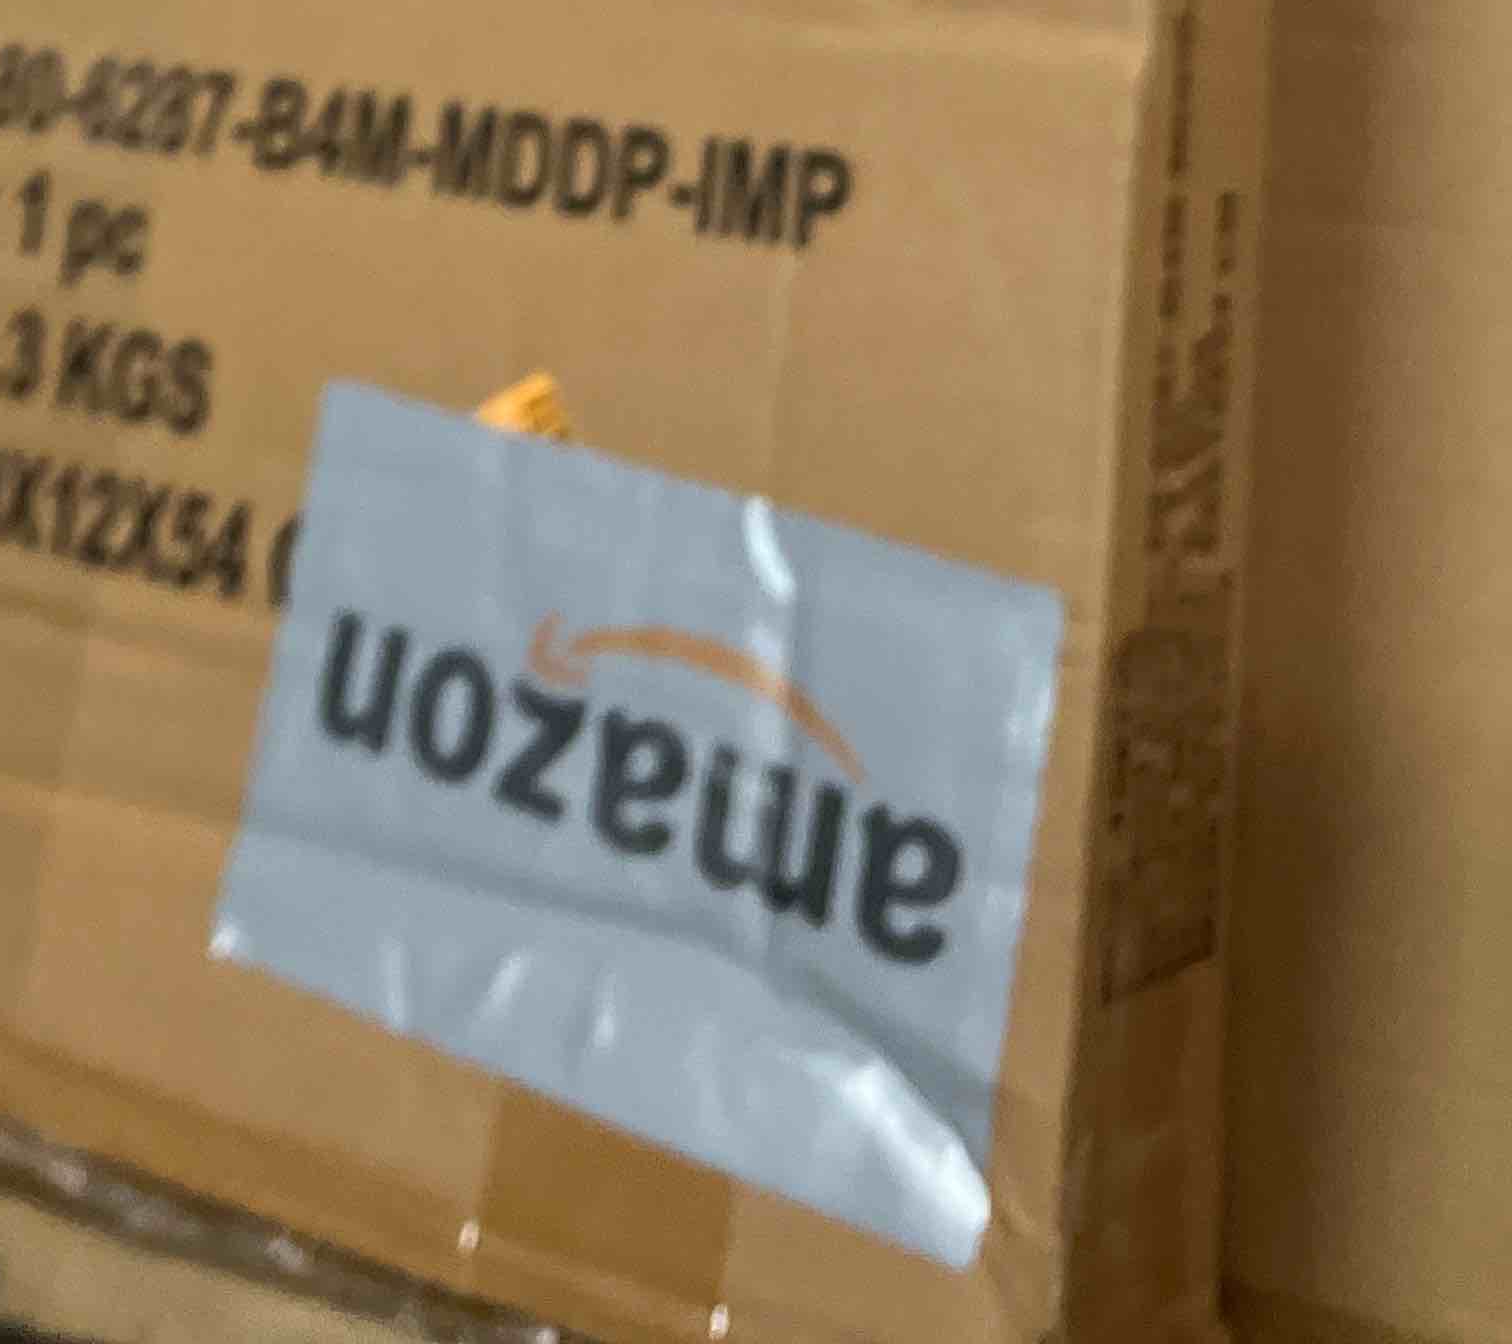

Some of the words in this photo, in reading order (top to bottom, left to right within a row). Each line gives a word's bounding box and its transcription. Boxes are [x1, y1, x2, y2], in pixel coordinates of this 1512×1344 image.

[18, 169, 51, 256] 1
[58, 199, 150, 289] pc
[54, 318, 212, 436] KGS
[316, 608, 964, 966] amazon
